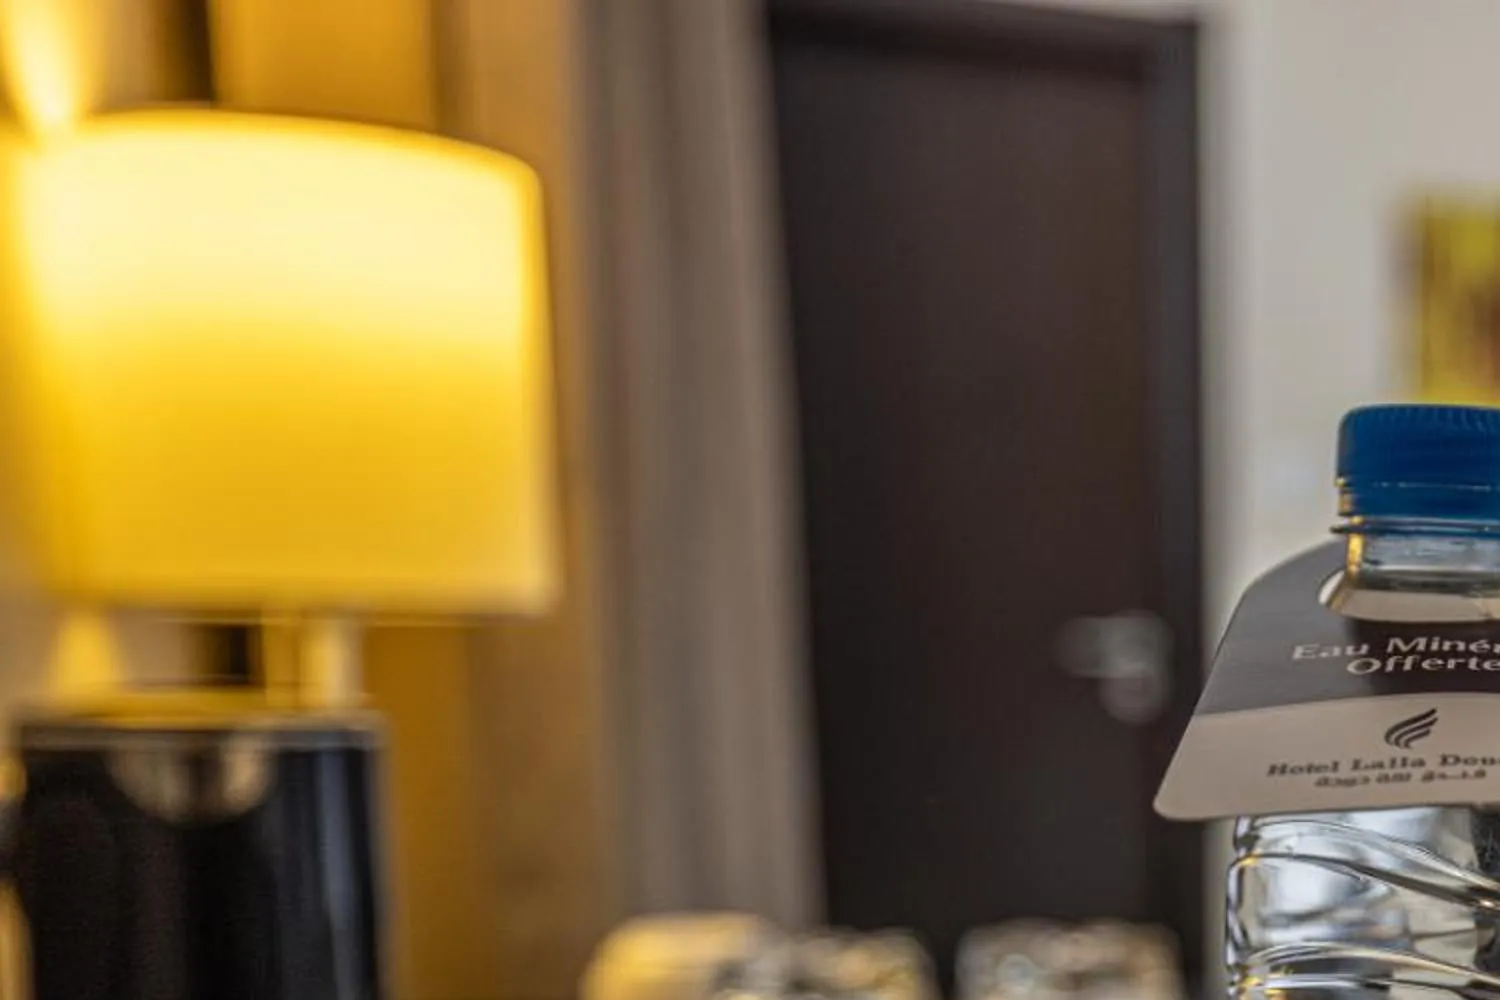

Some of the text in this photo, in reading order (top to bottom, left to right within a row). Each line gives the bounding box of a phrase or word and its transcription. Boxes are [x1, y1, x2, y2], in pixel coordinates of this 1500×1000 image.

[1292, 643, 1371, 660] Eau
[1267, 761, 1341, 777] Hotel
[1350, 757, 1427, 772] Lalla
